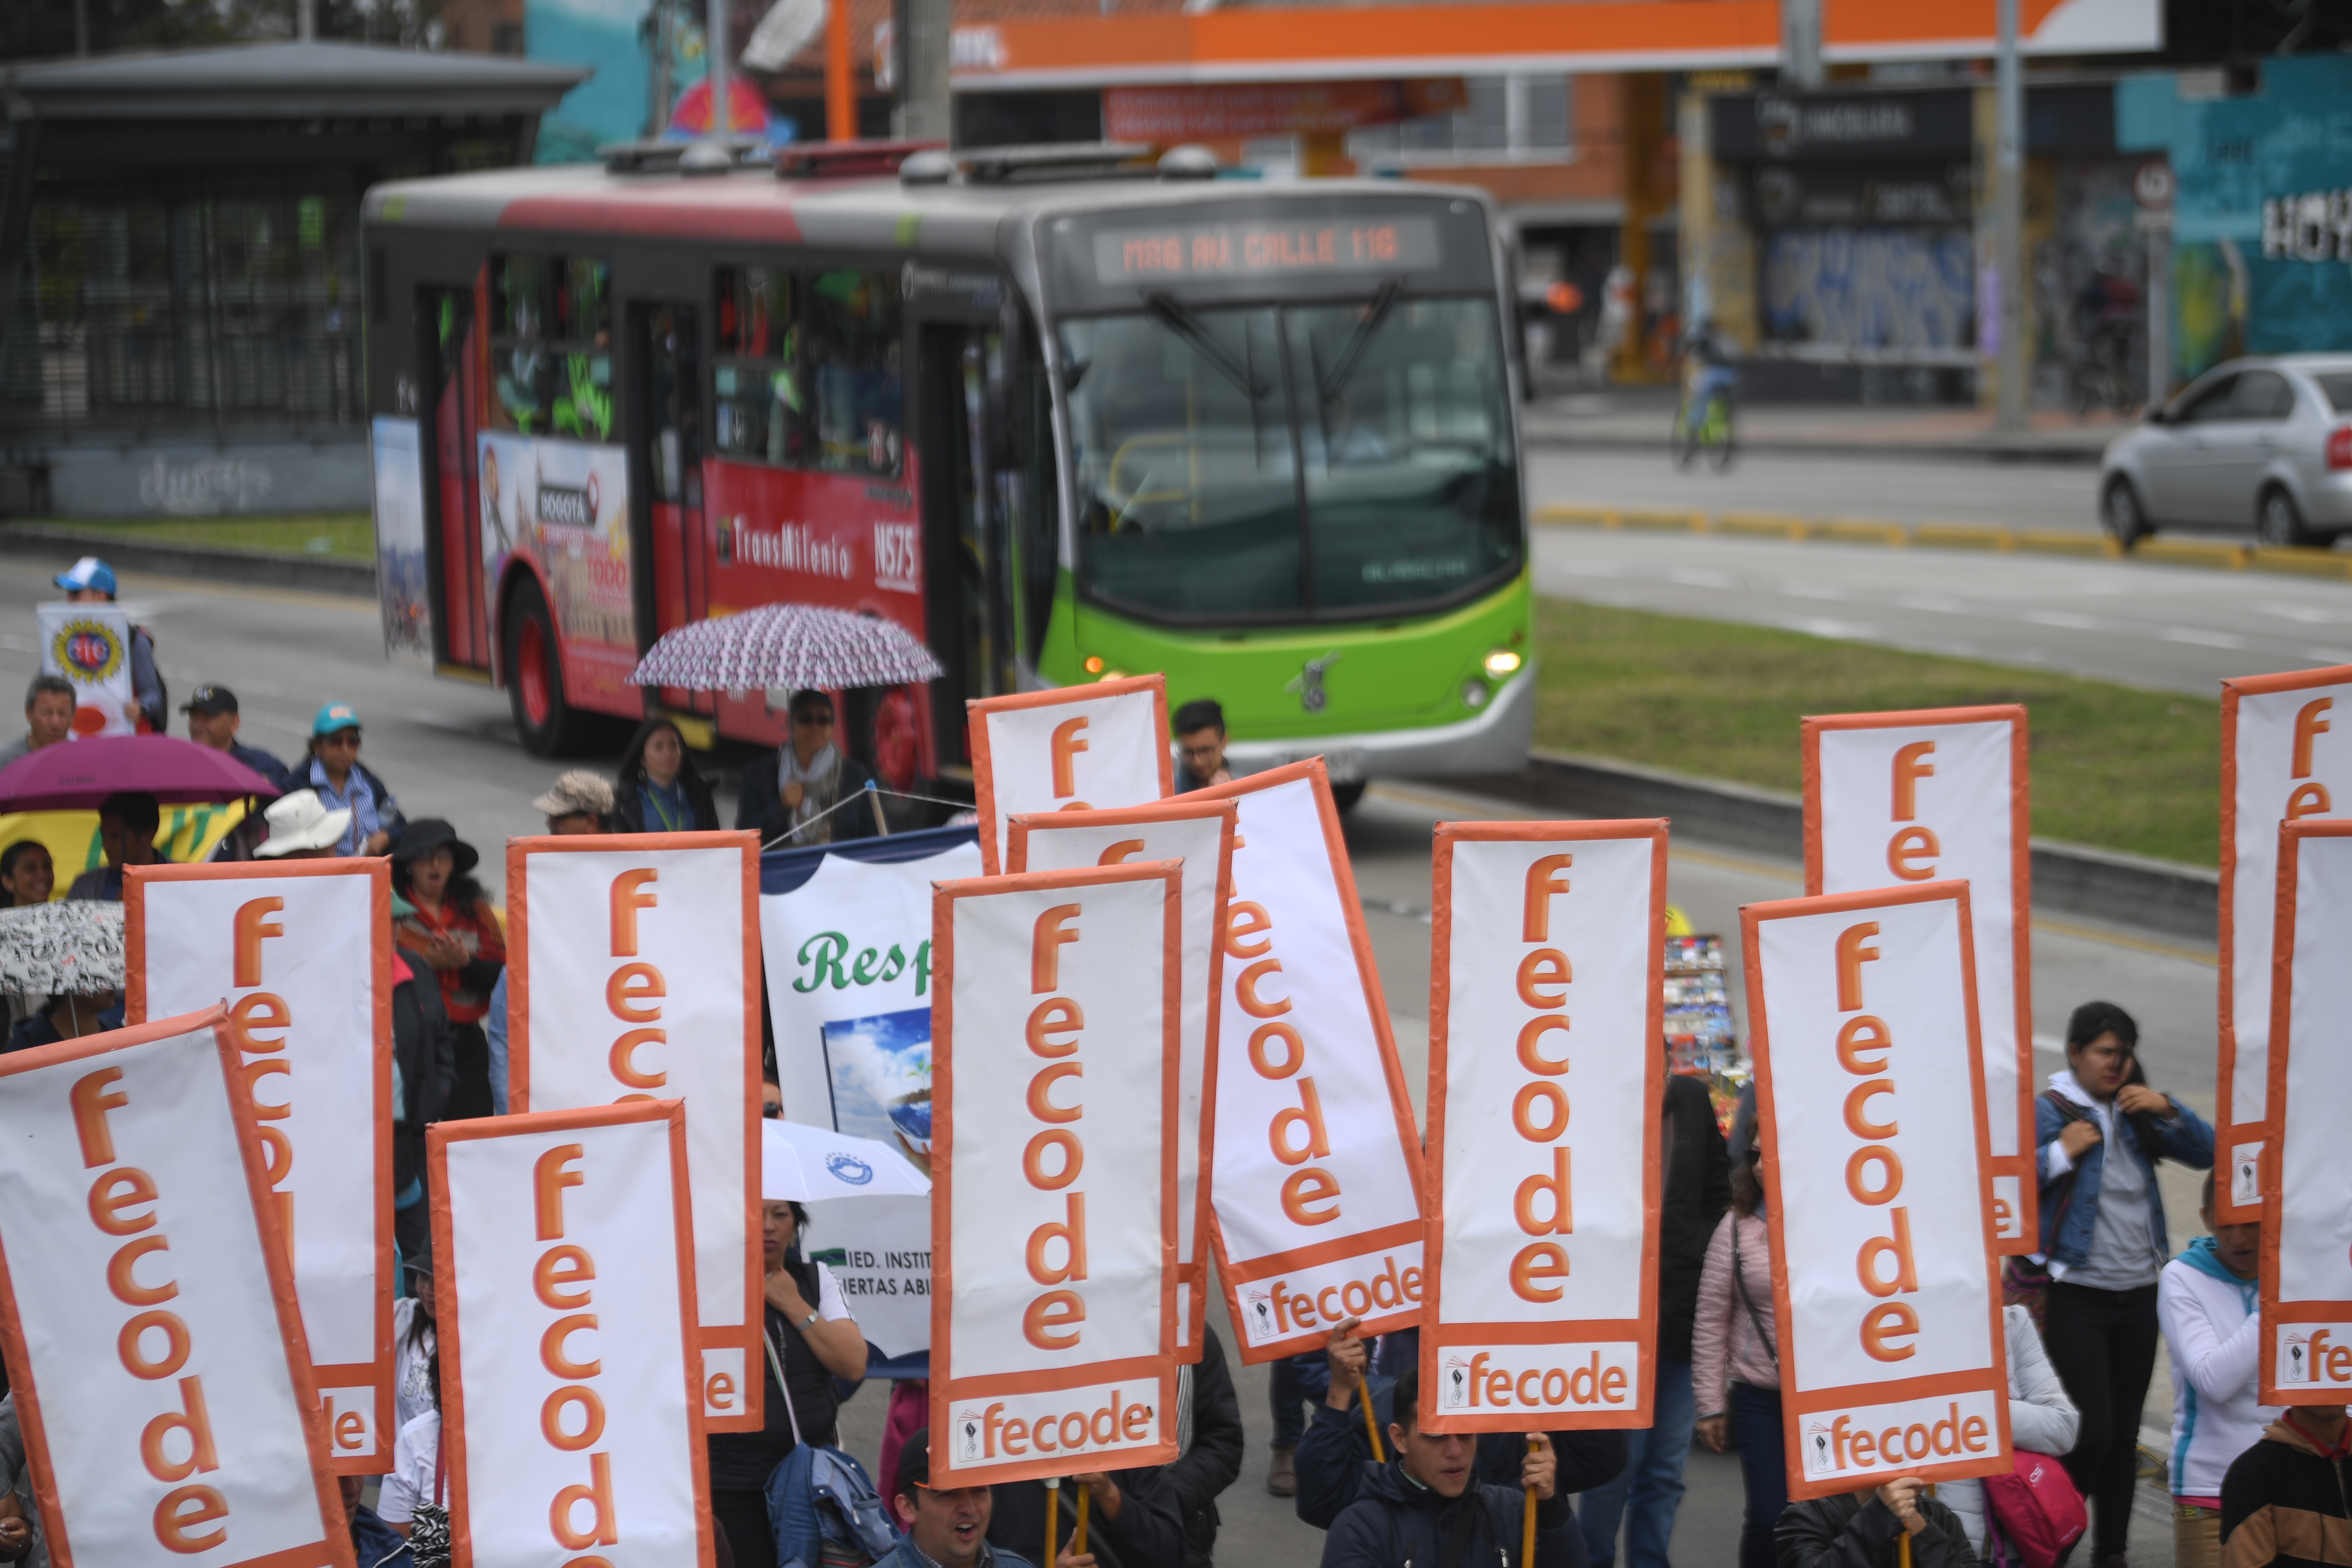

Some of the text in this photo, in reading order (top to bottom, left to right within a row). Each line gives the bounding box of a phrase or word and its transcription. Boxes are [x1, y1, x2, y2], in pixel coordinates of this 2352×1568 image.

[1243, 227, 1336, 269] CALLE
[1348, 224, 1398, 263] 116
[733, 513, 852, 581] TransMilenio
[1224, 812, 1341, 1227] ecode
[1508, 854, 1573, 1304] fecode
[1021, 903, 1087, 1351] fecode
[1834, 921, 1920, 1363] fecode
[848, 1251, 880, 1269] IED.
[1269, 1256, 1421, 1333] fecode
[69, 1066, 229, 1554] fecode
[532, 1143, 618, 1568] fecod
[1469, 1350, 1628, 1407] fecode
[982, 1389, 1150, 1459] fecode
[1830, 1402, 1988, 1471] fecode
